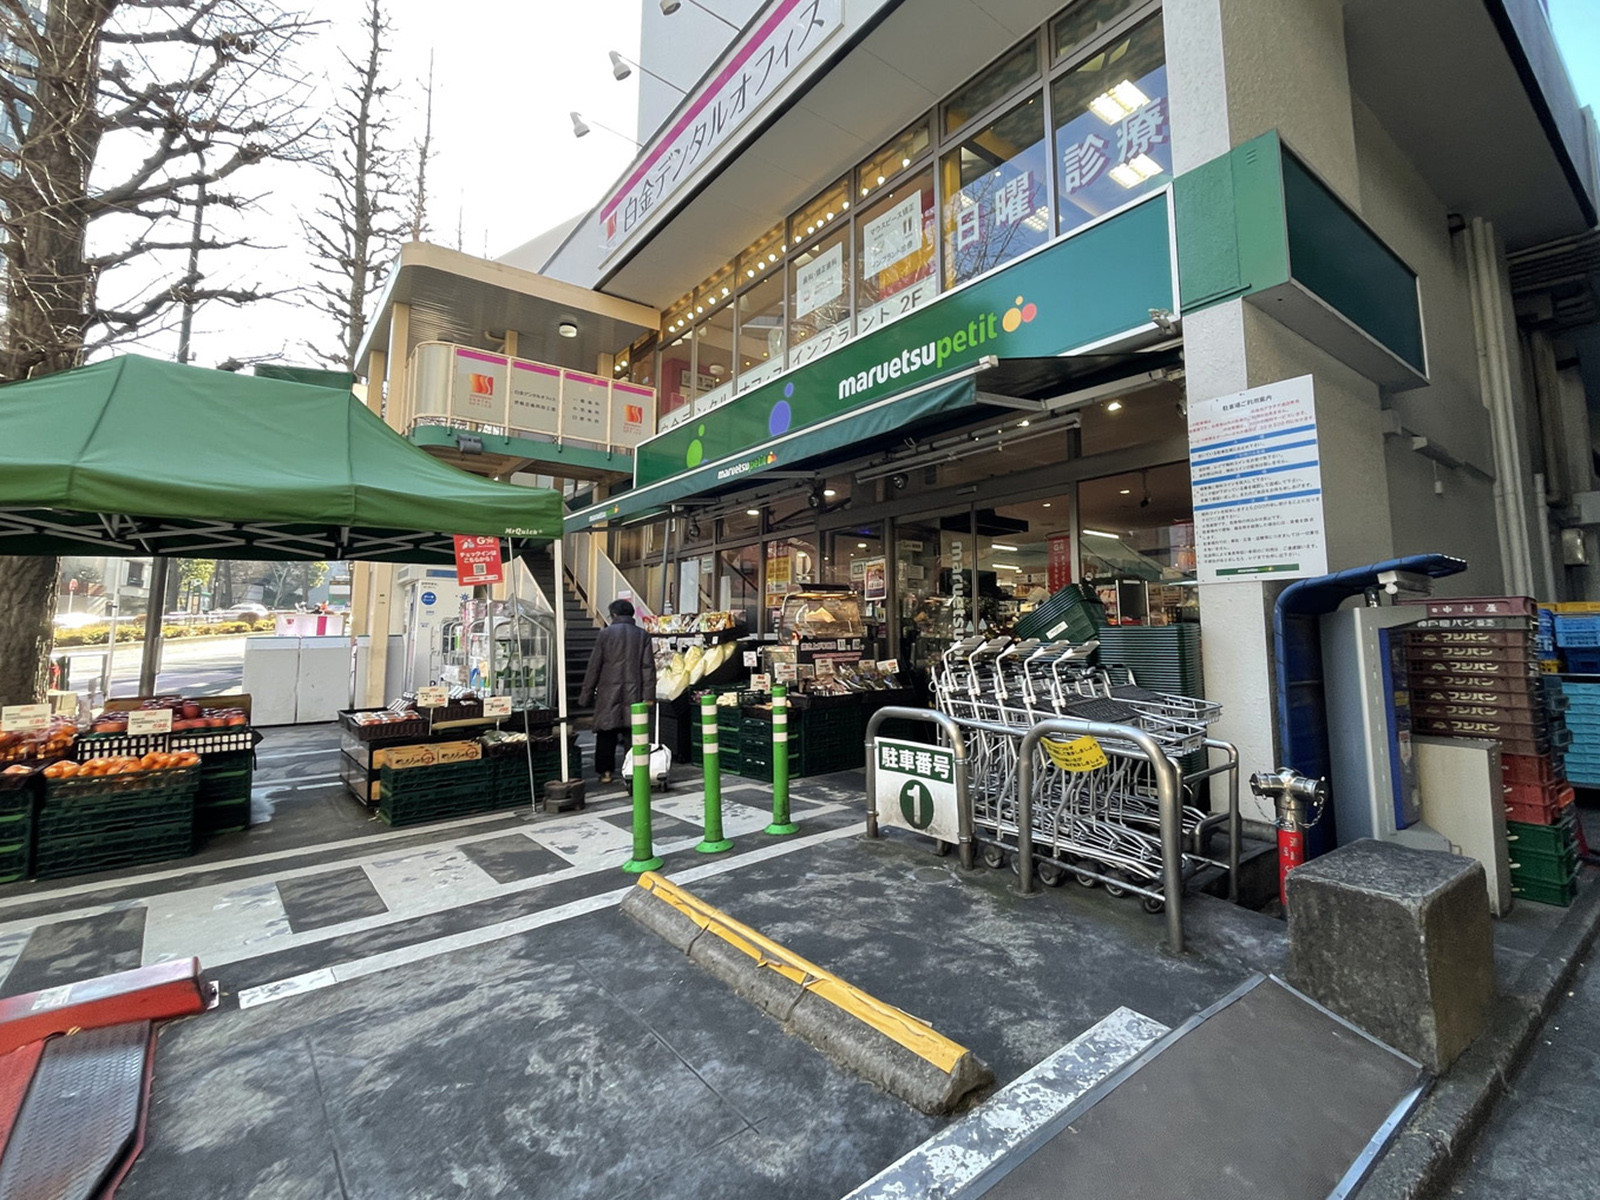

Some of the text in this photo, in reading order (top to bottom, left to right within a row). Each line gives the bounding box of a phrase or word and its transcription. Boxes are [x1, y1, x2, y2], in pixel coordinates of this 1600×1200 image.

[623, 0, 825, 233] 白金デンタルオフィス
[957, 97, 1165, 251] 日曜 診療
[900, 287, 924, 314] 2F
[881, 745, 952, 780] 駐車番号
[907, 784, 921, 825] 1
